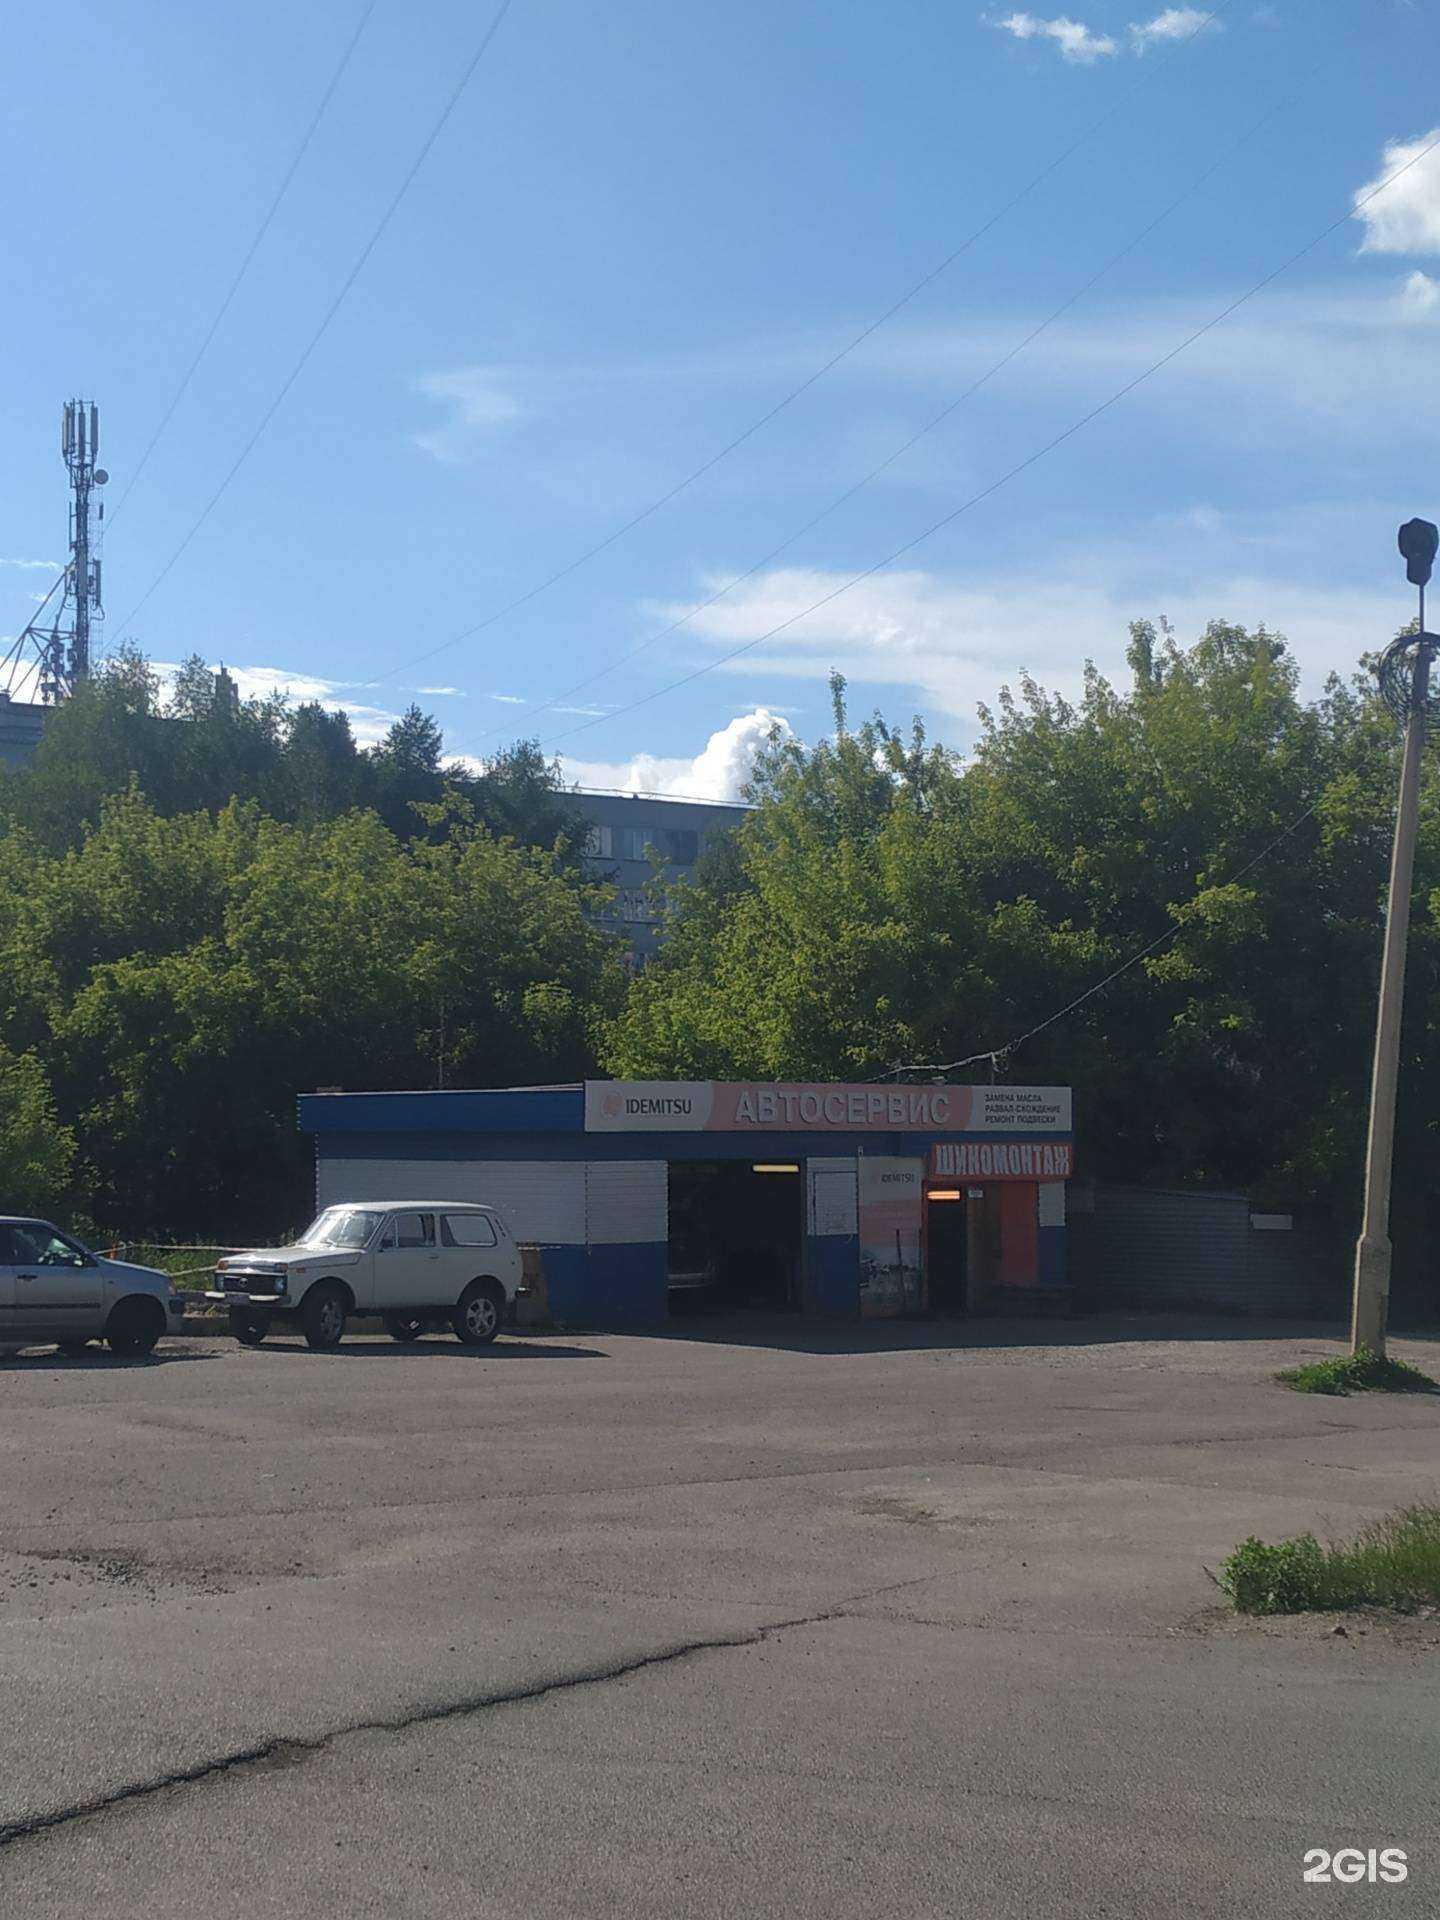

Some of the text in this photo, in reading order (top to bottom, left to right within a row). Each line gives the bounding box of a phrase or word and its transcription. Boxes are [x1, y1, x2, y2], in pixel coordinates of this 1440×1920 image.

[626, 1098, 692, 1114] IDEMITSU
[984, 1094, 1042, 1102] ЗАМЕНА МАСЛА
[735, 1090, 950, 1125] АВТОСЕРВИС
[984, 1115, 1056, 1123] РЕМОНТ ПОДВЕСКИ
[935, 1144, 1070, 1176] ШИНОМОНТАЖ
